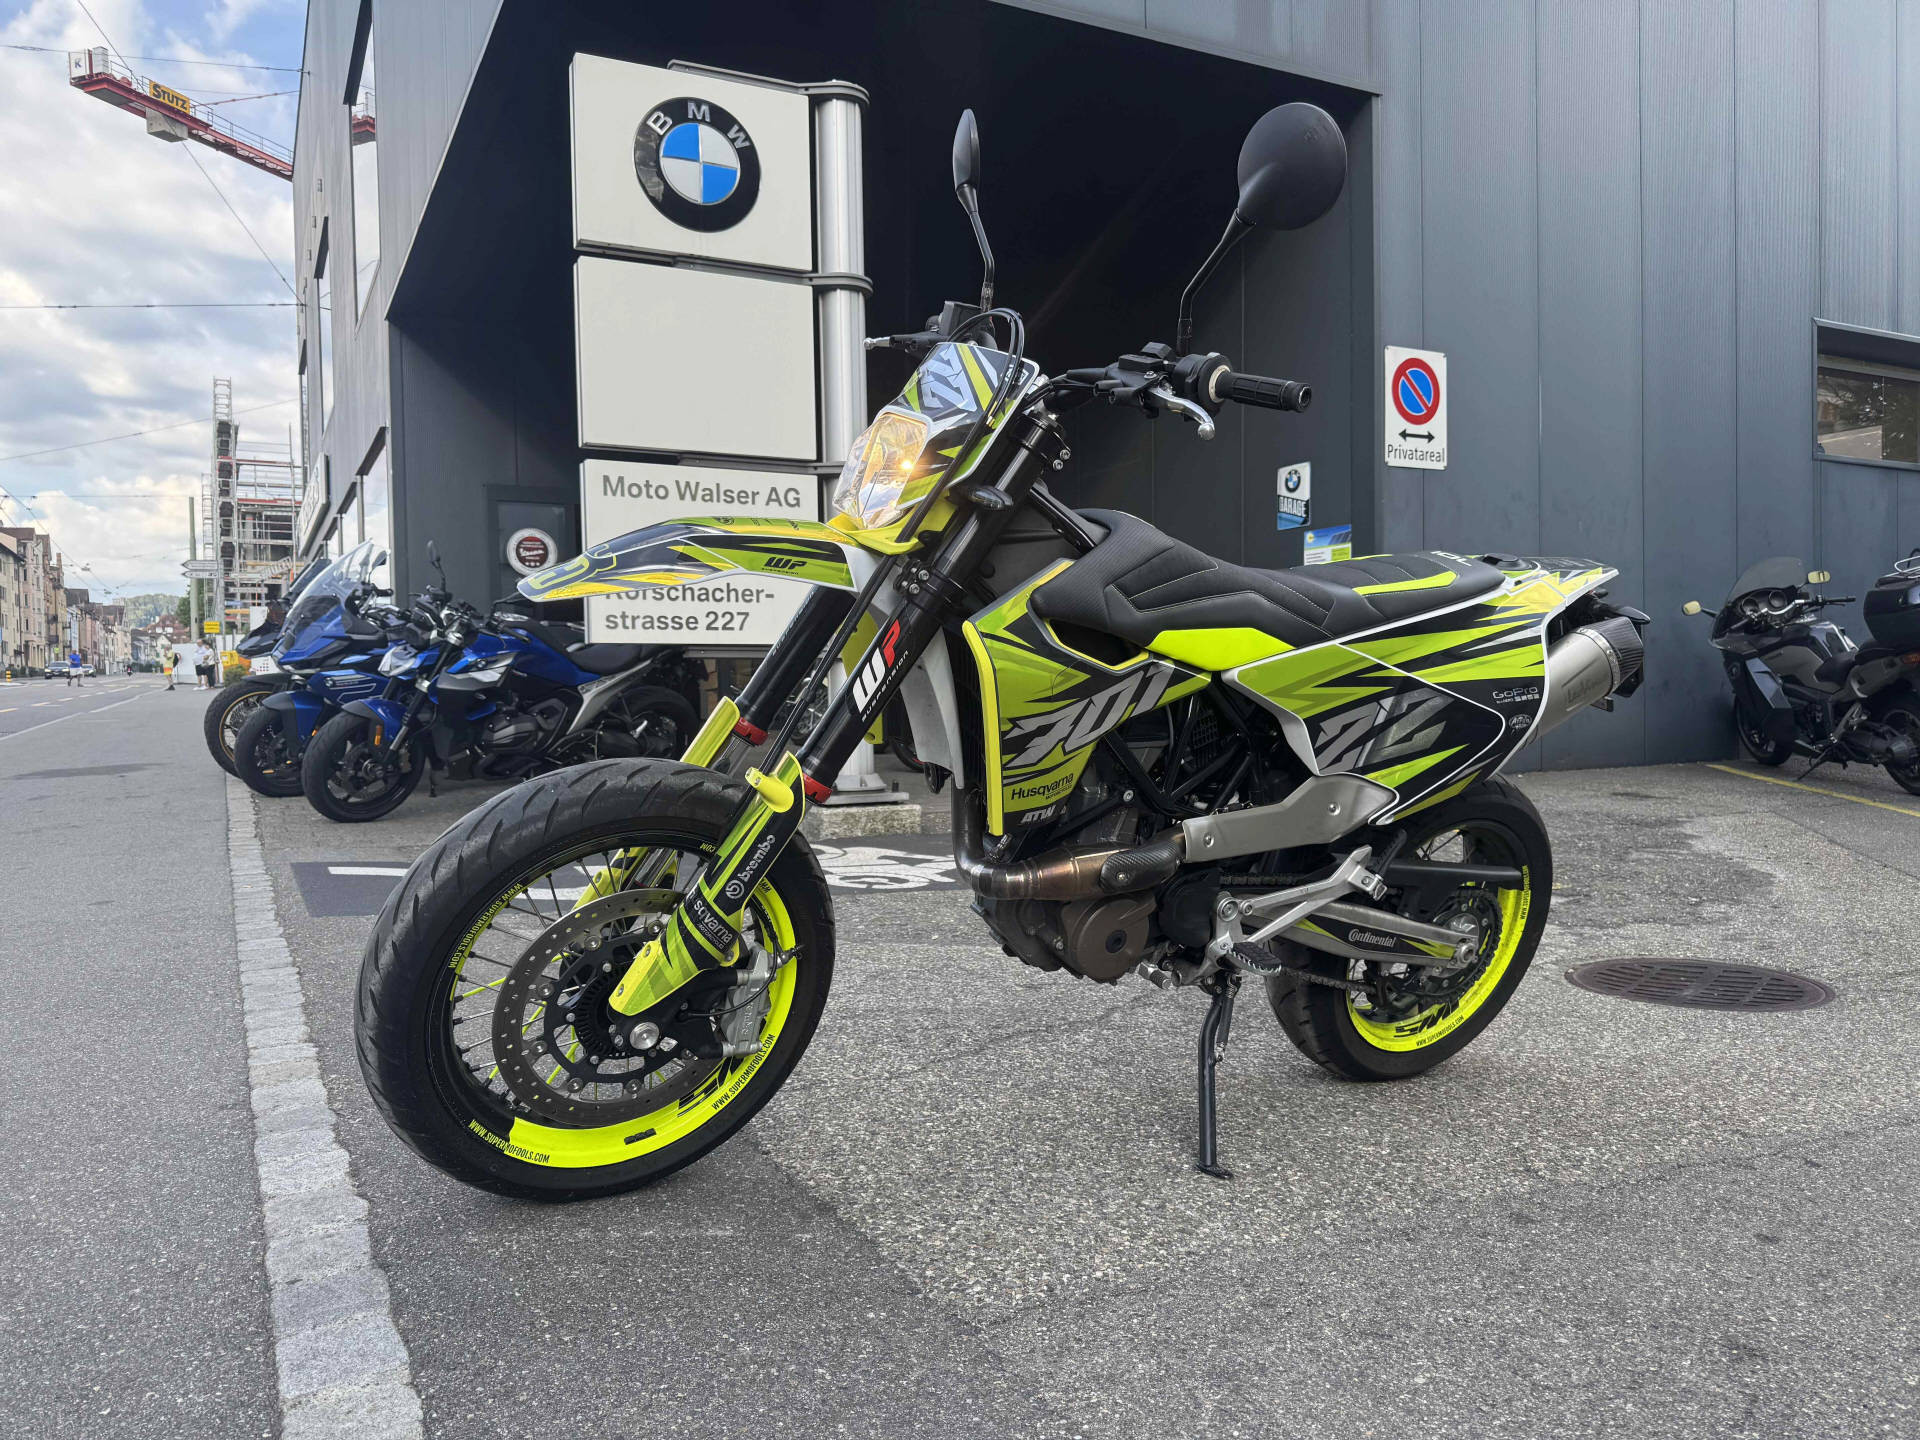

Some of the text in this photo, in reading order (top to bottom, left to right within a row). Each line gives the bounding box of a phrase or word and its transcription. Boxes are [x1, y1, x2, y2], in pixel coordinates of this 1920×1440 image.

[646, 100, 751, 150] BMW
[1387, 444, 1445, 463] Privatareal
[602, 474, 801, 508] Moto Walser AG
[1278, 496, 1308, 518] GARAGE
[605, 611, 750, 631] strasse 227
[1492, 686, 1538, 700] GoPro
[1011, 773, 1074, 801] Husqvarna
[737, 834, 776, 882] brembo
[1347, 928, 1397, 948] Continental
[711, 1033, 776, 1111] WWW.SUPERMOFOOLS.COM
[467, 1119, 551, 1164] WWW.SUPERMOFOOLS.COM
